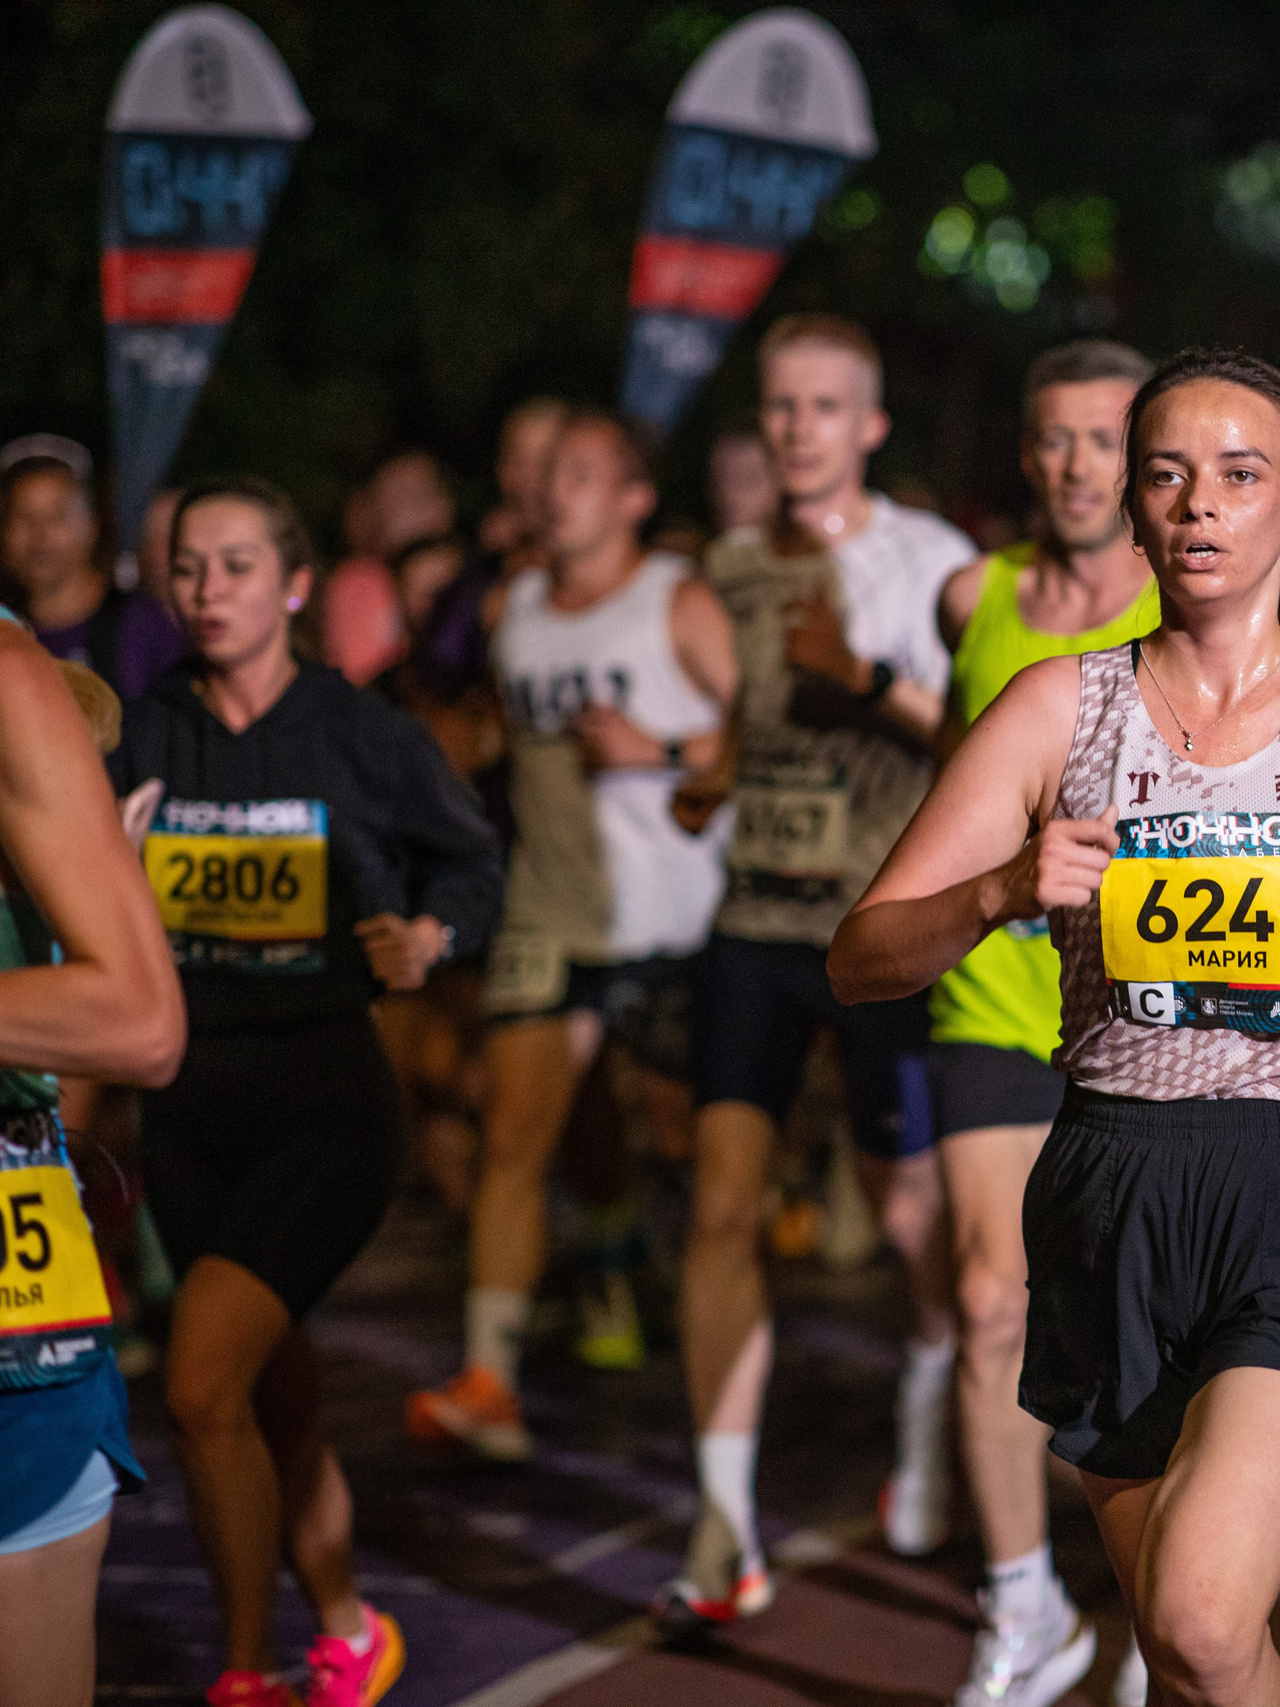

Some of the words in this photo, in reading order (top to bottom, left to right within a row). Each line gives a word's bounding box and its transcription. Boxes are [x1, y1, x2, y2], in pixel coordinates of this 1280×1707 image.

[1114, 847, 1188, 859] 2024
[166, 853, 299, 902] 2806
[1188, 949, 1267, 969] МАРИЯ
[0, 1192, 51, 1275] 5
